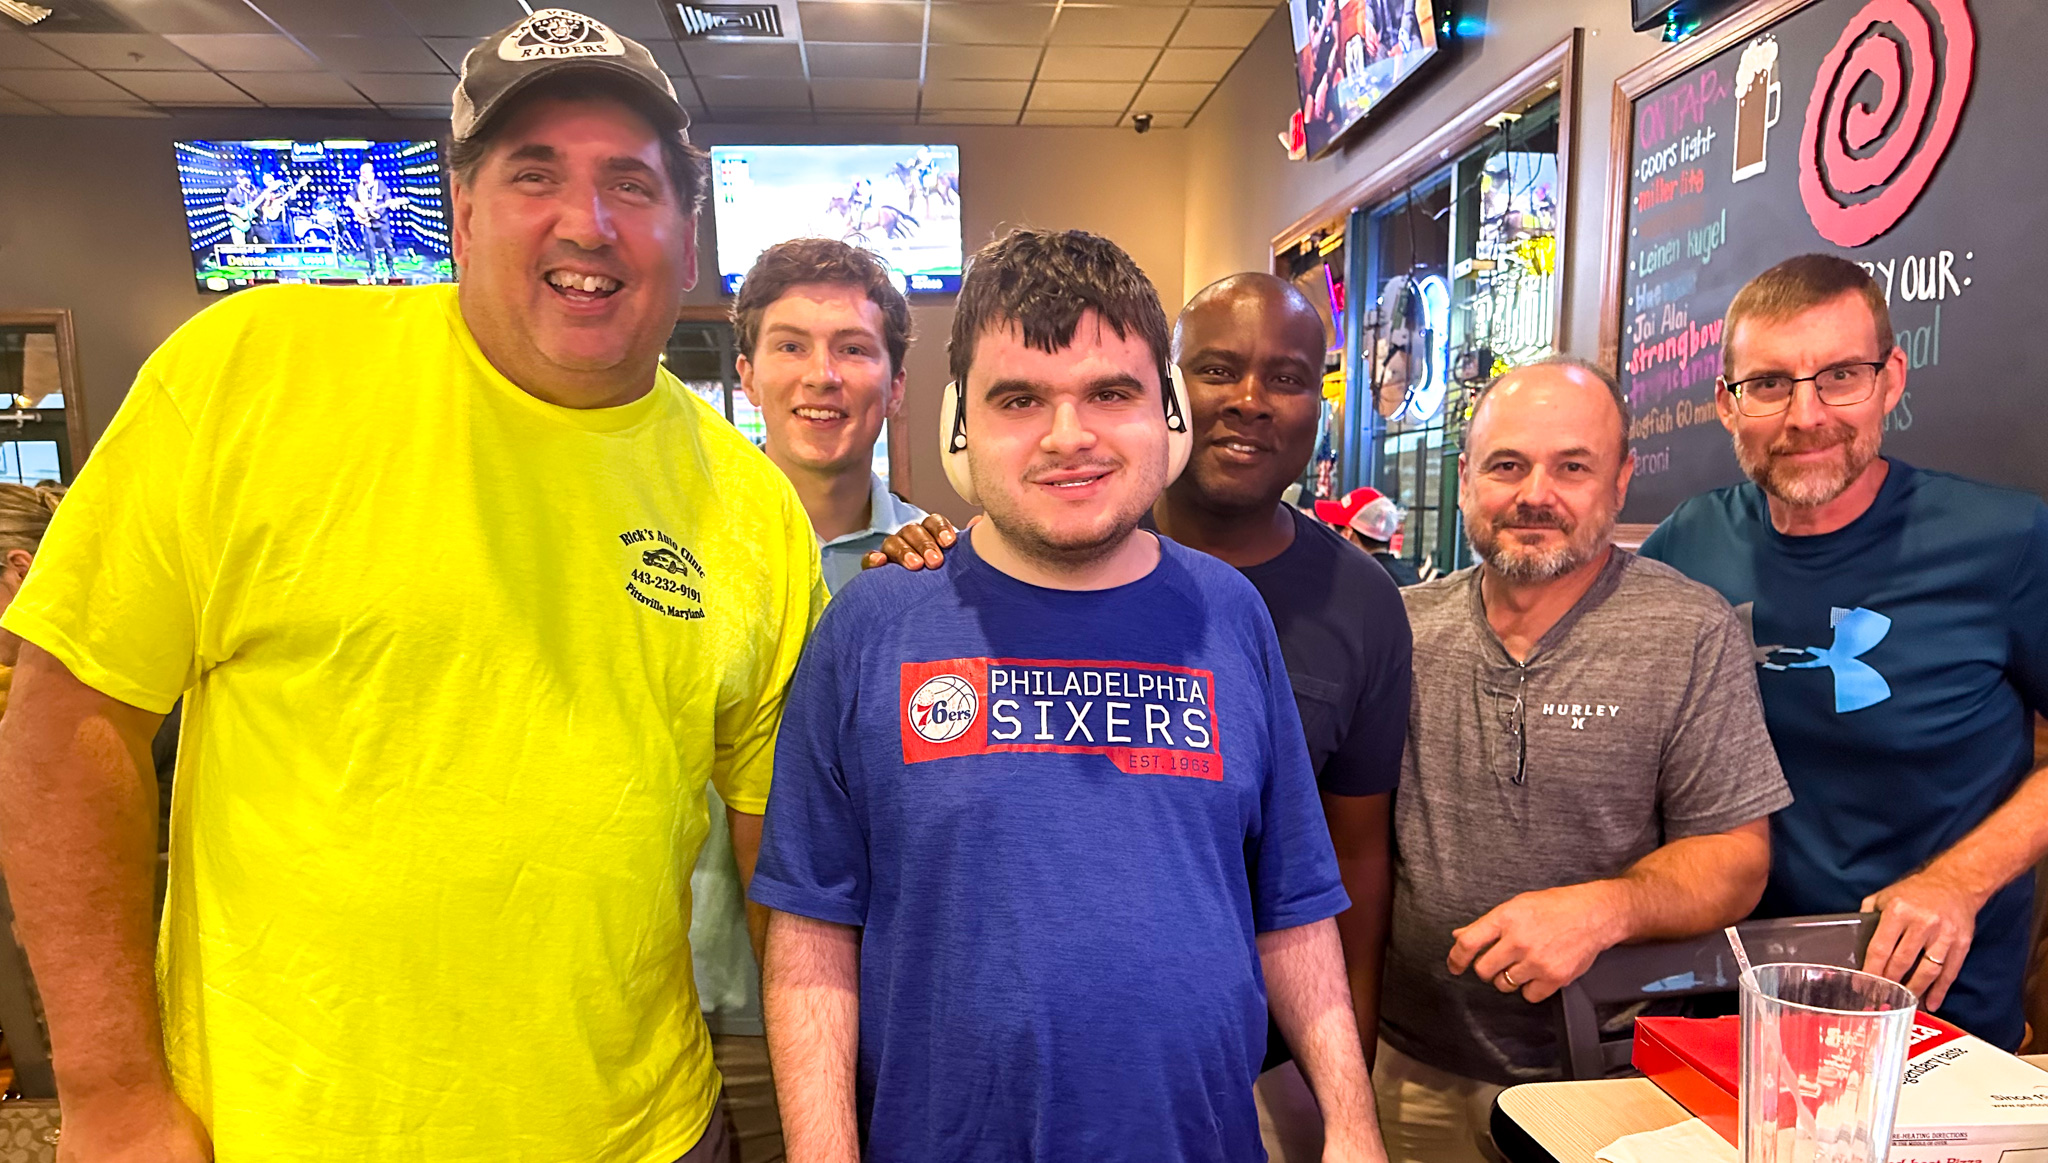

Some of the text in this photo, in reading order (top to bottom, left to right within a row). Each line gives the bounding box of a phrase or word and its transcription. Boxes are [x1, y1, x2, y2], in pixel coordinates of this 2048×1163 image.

[521, 44, 608, 58] RAIDERS
[1641, 125, 1717, 183] coors light
[1638, 177, 1679, 213] miller
[1638, 238, 1681, 278] Leinen
[1633, 302, 1689, 344] Jai Alai
[1629, 318, 1724, 376] strongbow
[1628, 406, 1674, 441] dogfish
[1676, 399, 1693, 428] 60
[618, 528, 706, 579] Rick's Auto Clinic
[625, 581, 706, 621] Pittsville, Maryland
[630, 568, 702, 604] 443-232-9191
[990, 669, 1207, 706] PHILADELPHIA
[915, 700, 973, 728] 76ers
[990, 699, 1211, 750] SIXERS
[1542, 703, 1620, 717] HURLEY
[1128, 754, 1211, 774] EST. 1963
[1931, 1131, 1968, 1139] DIRECTIONS
